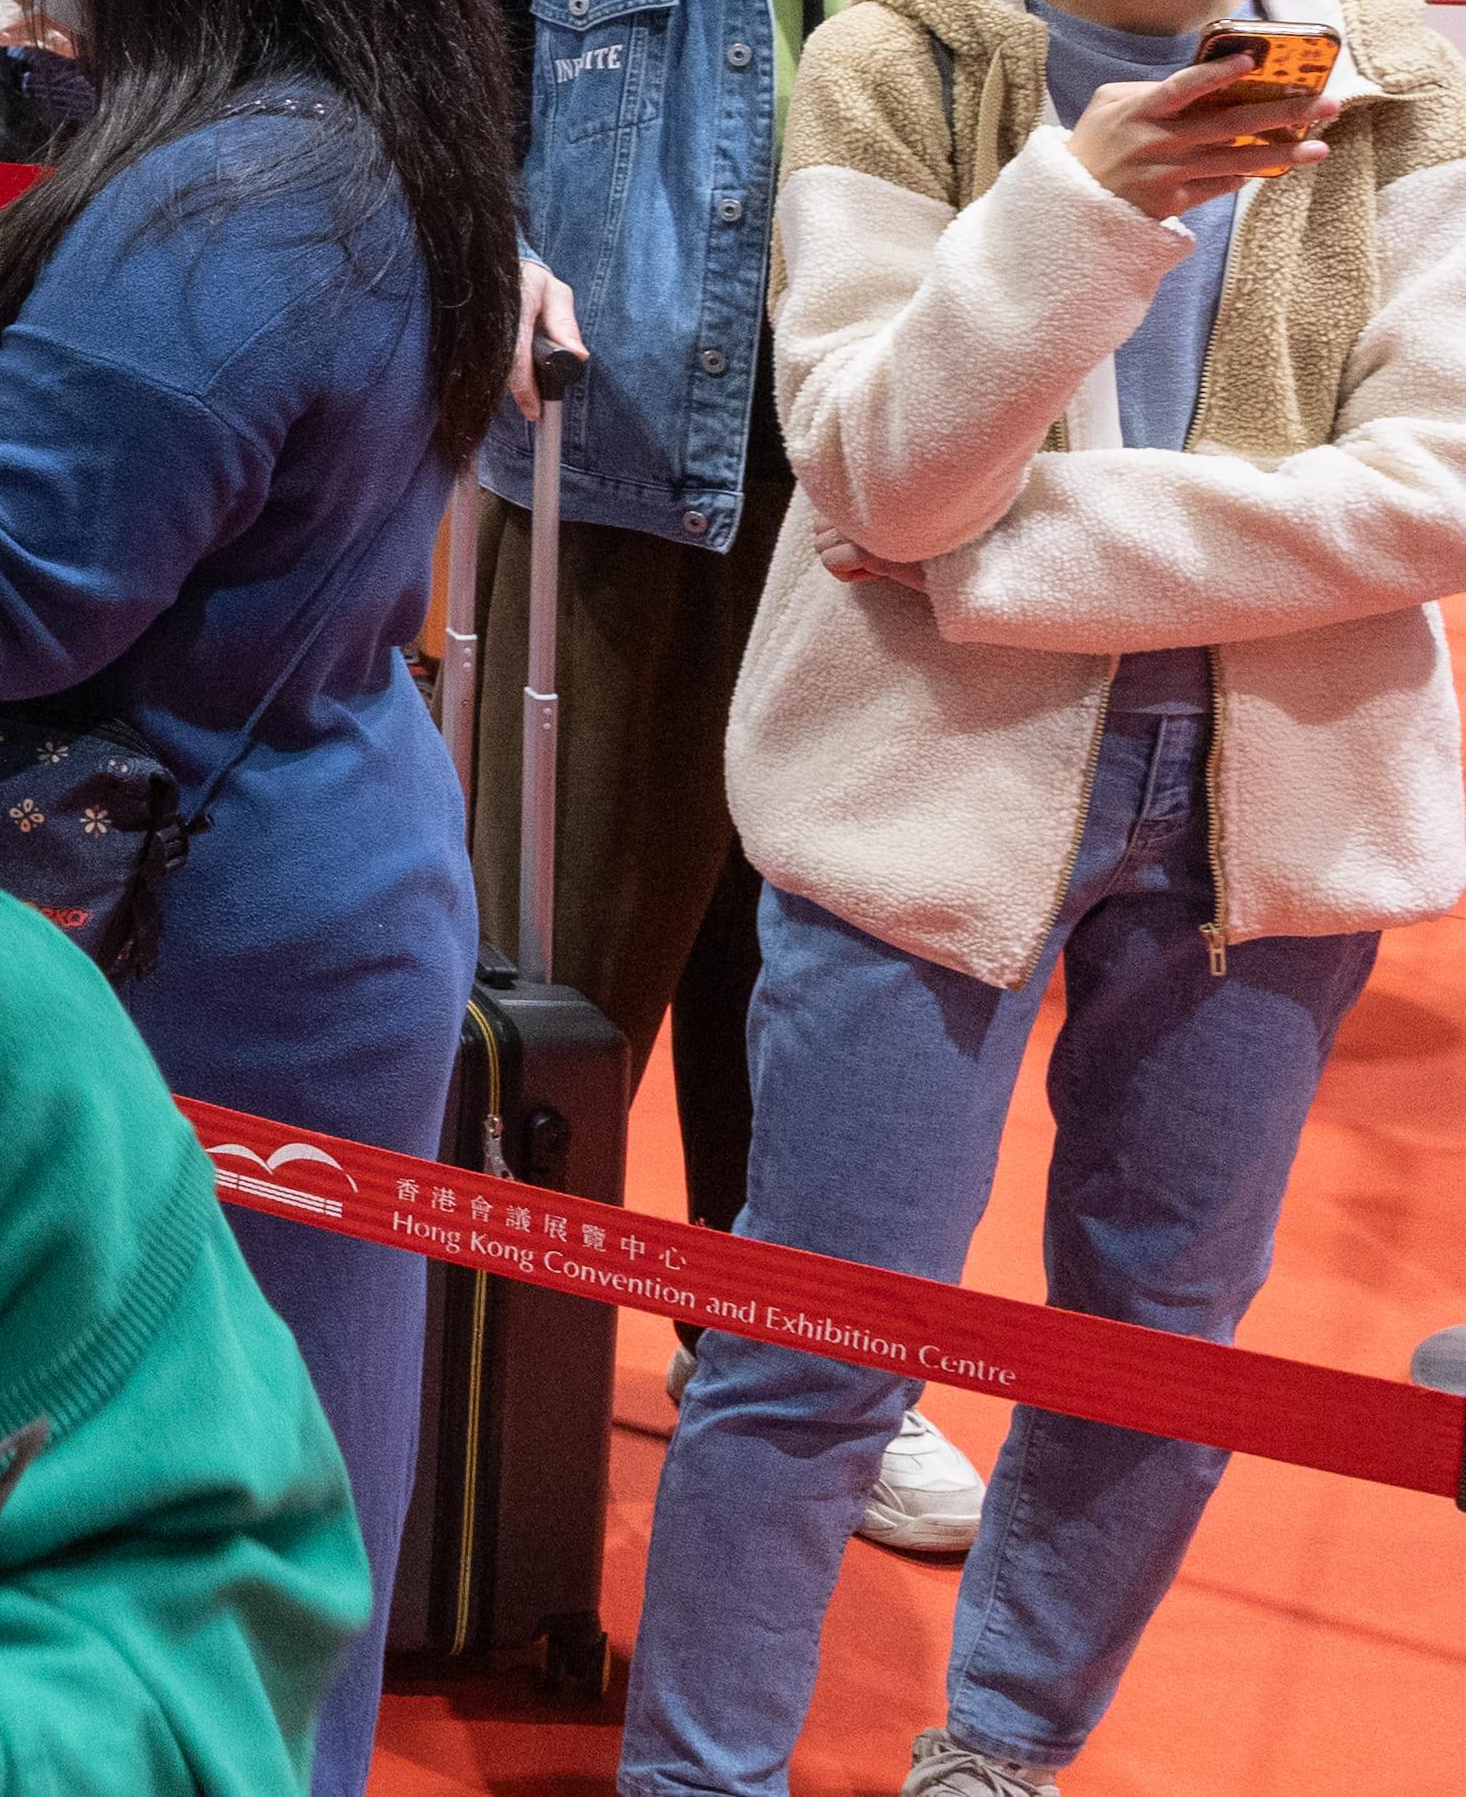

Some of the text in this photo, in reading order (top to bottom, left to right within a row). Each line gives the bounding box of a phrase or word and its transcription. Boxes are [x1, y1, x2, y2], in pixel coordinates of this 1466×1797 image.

[396, 1177, 688, 1272] 香港會議展覽中心
[392, 1211, 1017, 1388] Hong Kong Convention and Exhibition Centre
